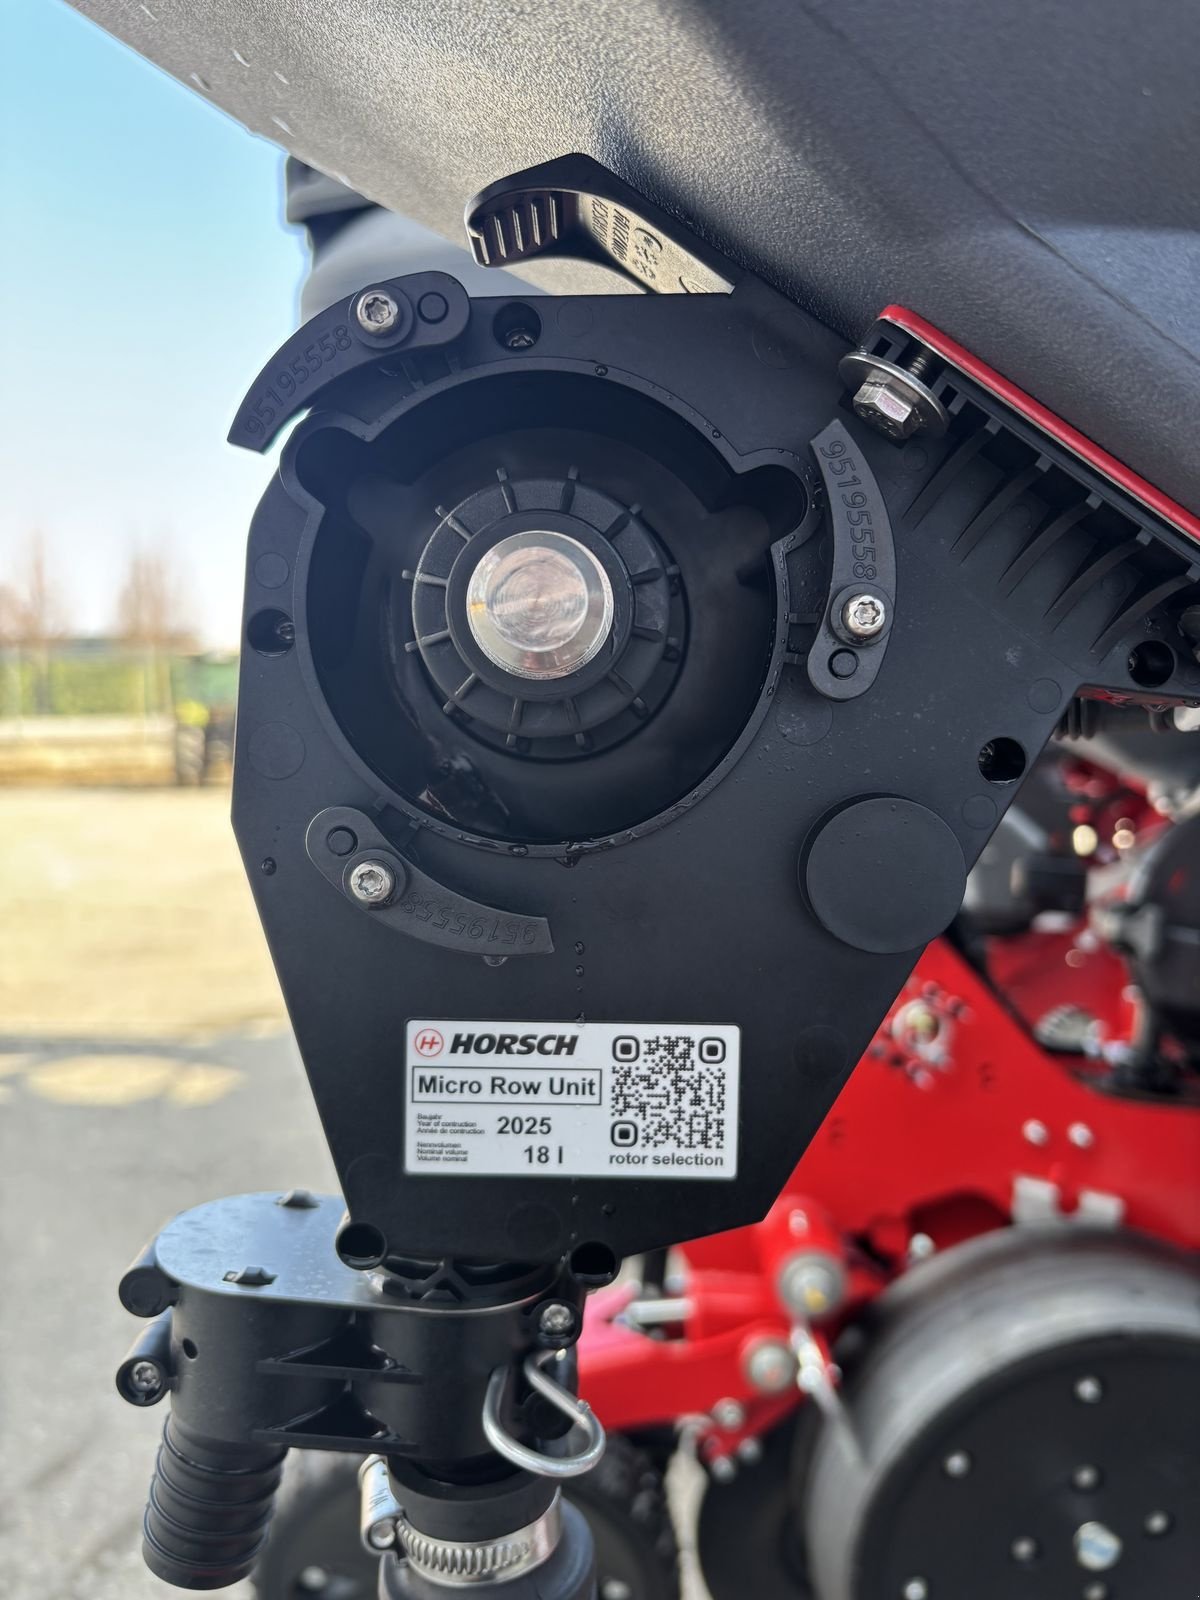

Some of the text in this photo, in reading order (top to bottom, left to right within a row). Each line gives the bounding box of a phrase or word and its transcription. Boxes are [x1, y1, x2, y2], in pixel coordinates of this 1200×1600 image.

[244, 324, 353, 438] 95195558
[819, 440, 877, 581] 95195558
[401, 891, 538, 946] 95195558
[449, 1033, 578, 1056] HORSCH
[418, 1075, 596, 1096] Micro Row Unit
[497, 1116, 552, 1135] 2025
[524, 1146, 549, 1164] 18
[609, 1153, 724, 1166] rotor selection
